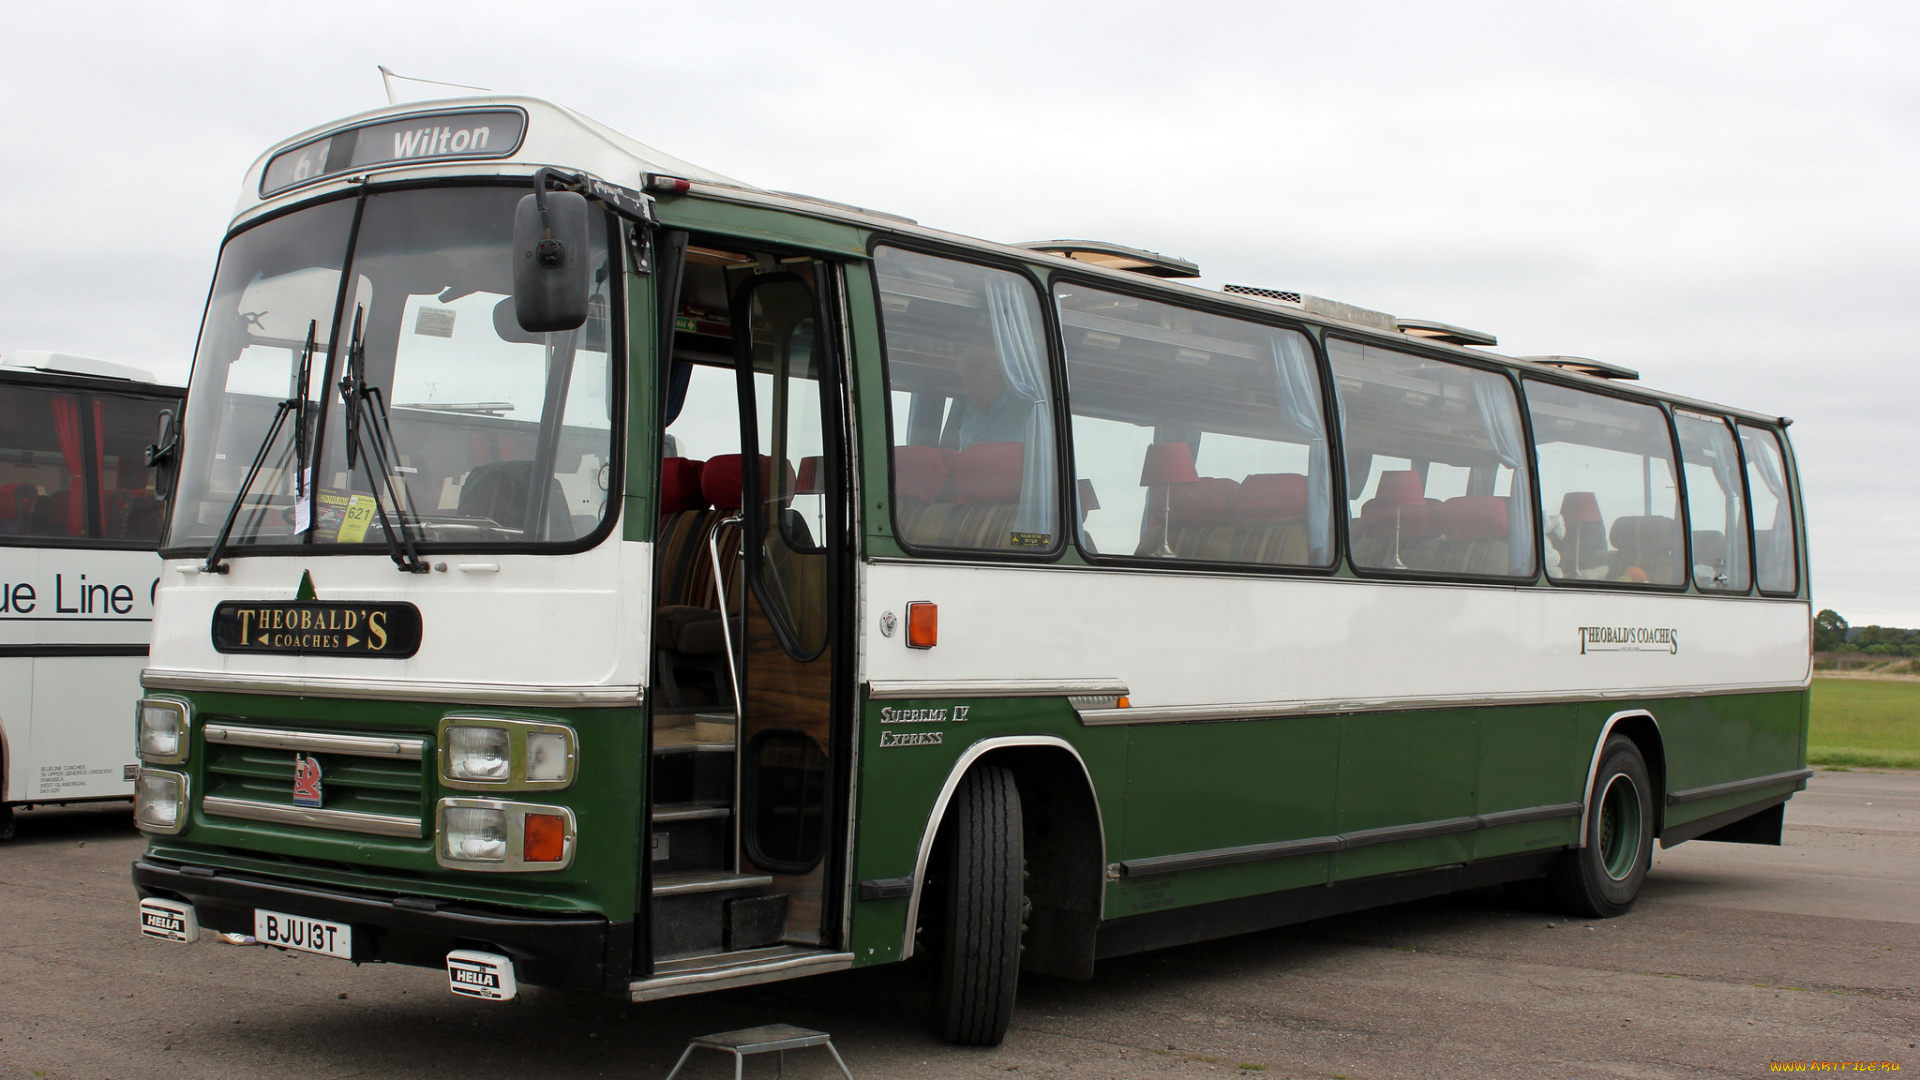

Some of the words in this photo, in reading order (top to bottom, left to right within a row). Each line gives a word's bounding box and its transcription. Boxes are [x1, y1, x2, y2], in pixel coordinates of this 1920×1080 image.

[394, 125, 490, 159] Wilton
[348, 507, 371, 521] 621
[55, 573, 134, 614] Line
[237, 609, 388, 650] THEOBALD'S
[274, 634, 340, 648] COACHES
[1578, 627, 1636, 655] THEOBALD'S
[1637, 628, 1678, 655] COACHES
[880, 707, 947, 723] SUPREME
[952, 706, 970, 722] IV
[879, 731, 943, 747] EXPRESS
[147, 915, 180, 930] HELLA
[266, 915, 338, 952] BJU13T
[456, 970, 493, 986] HELLA
